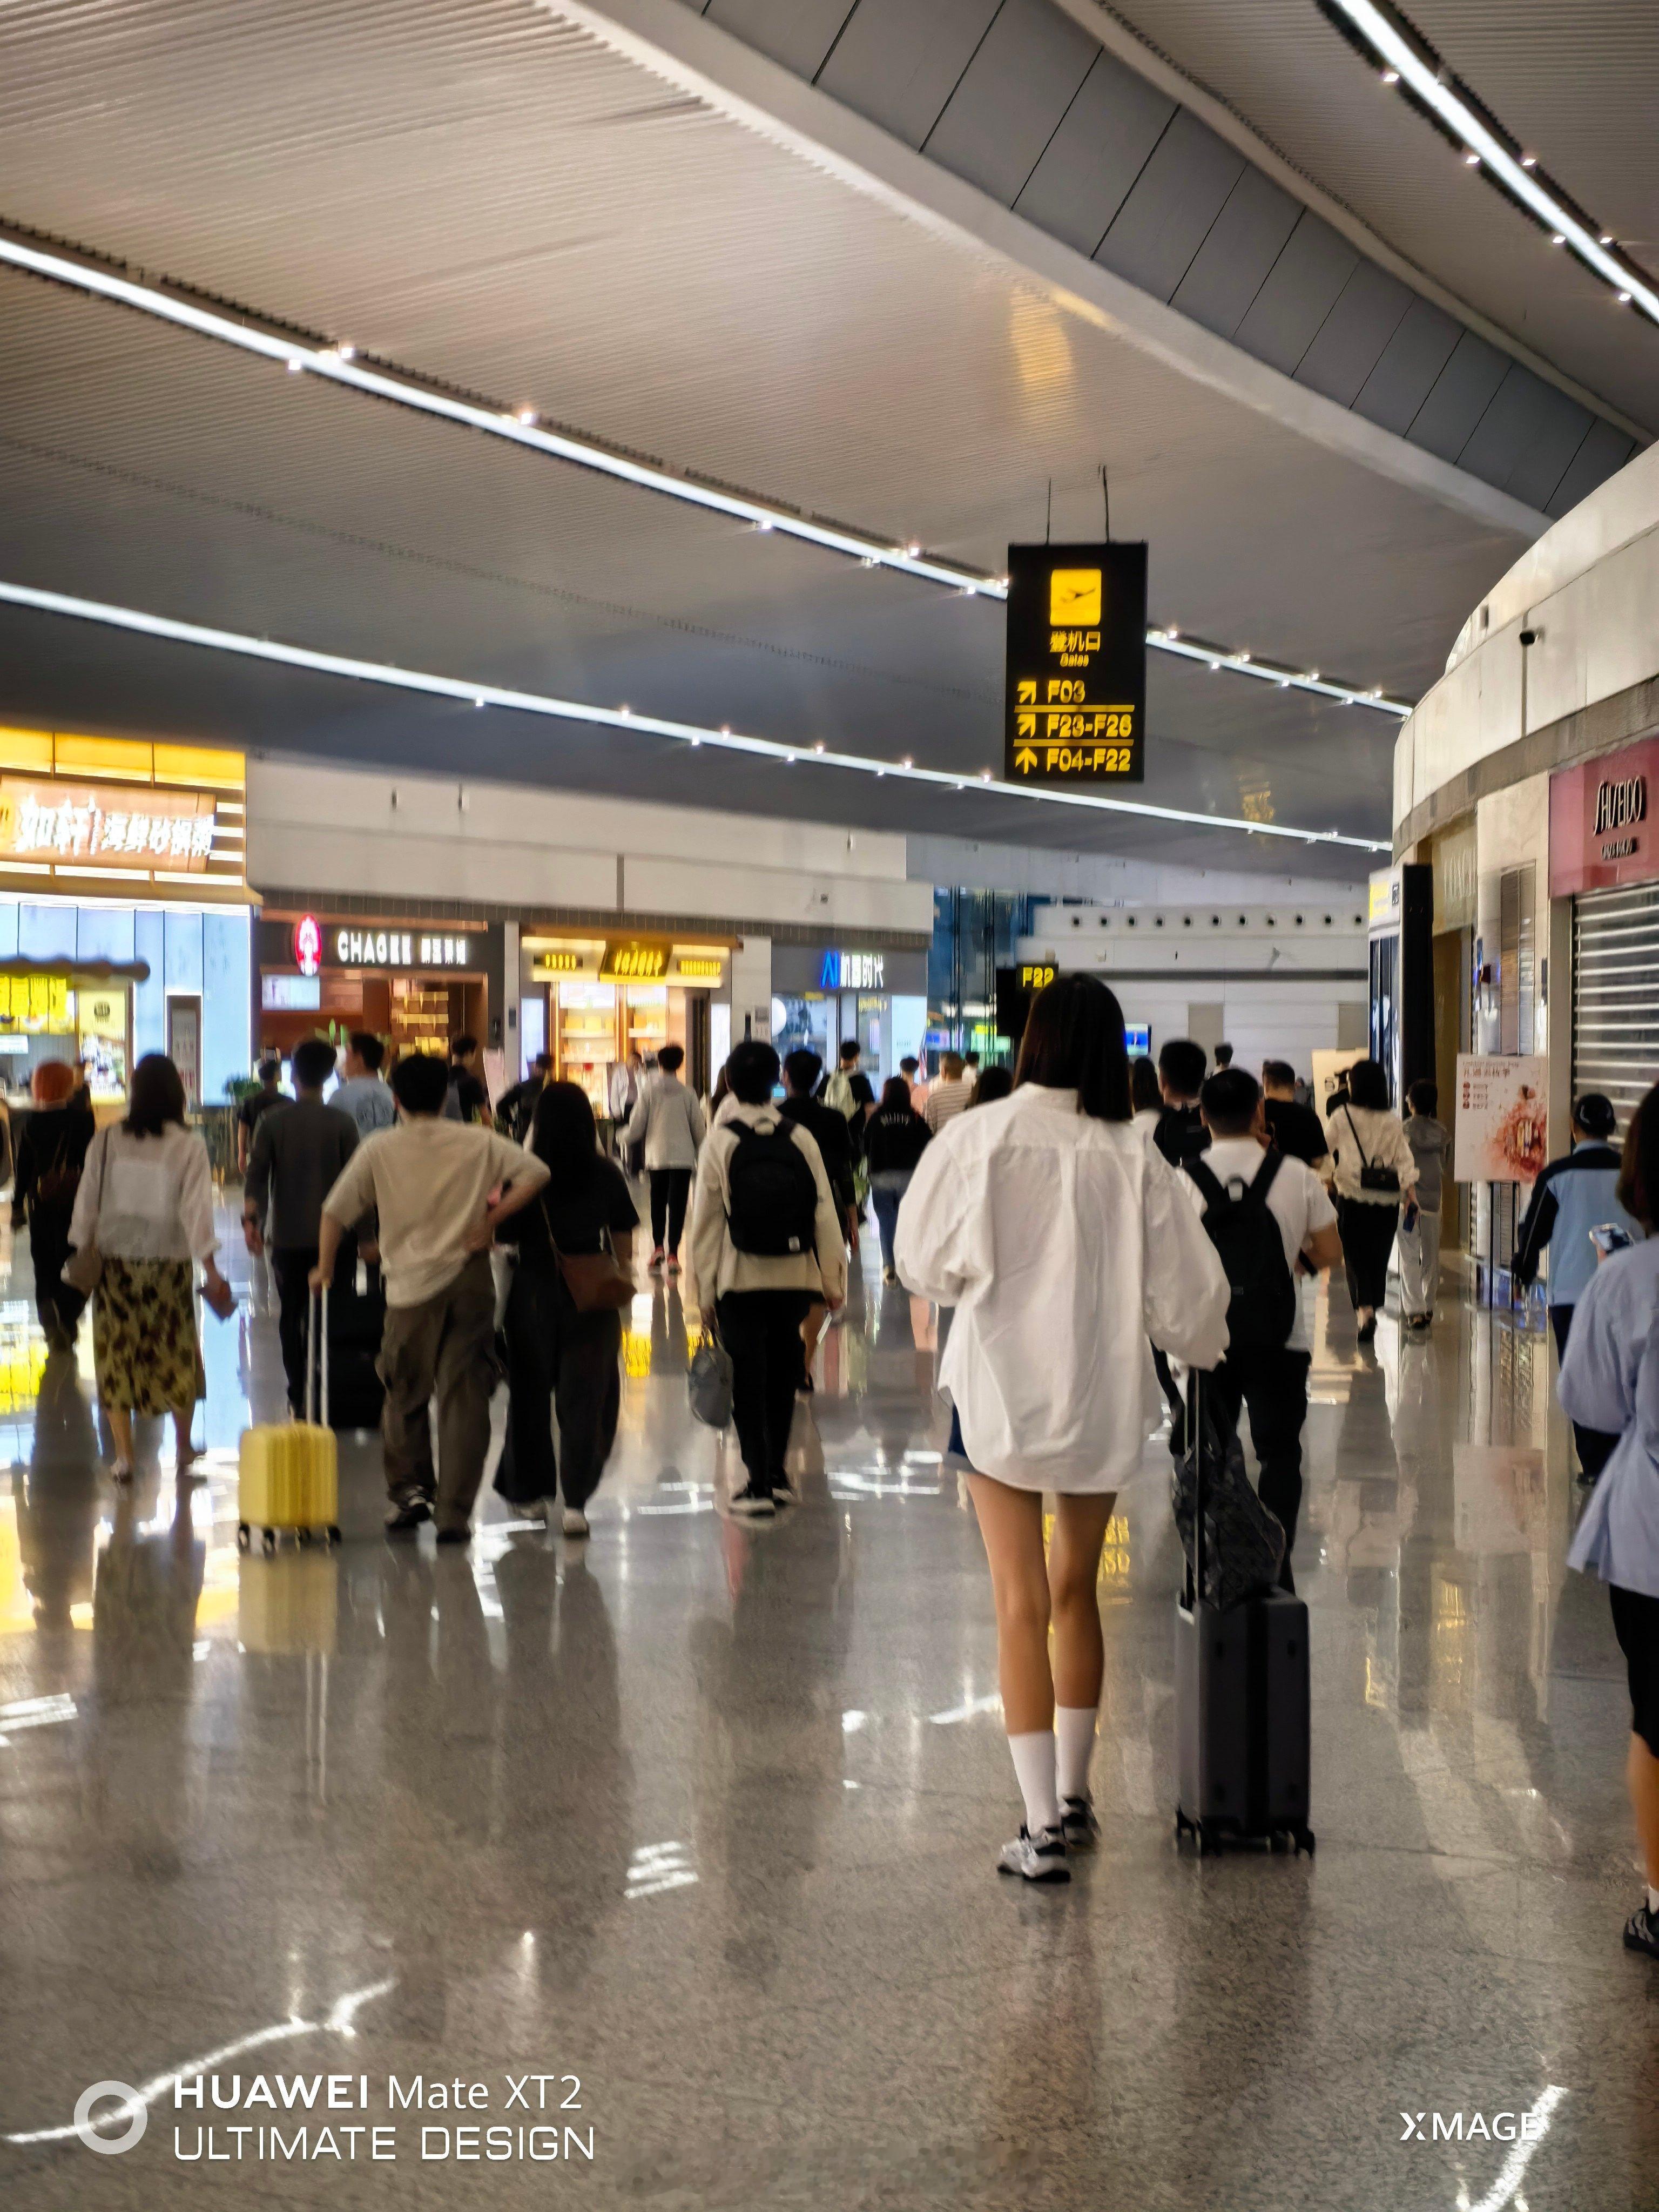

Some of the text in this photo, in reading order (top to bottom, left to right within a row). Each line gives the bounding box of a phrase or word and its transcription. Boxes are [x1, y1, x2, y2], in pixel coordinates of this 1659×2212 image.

[1048, 680, 1085, 703] F03
[1047, 748, 1131, 772] F04-F22
[1023, 967, 1054, 988] F22
